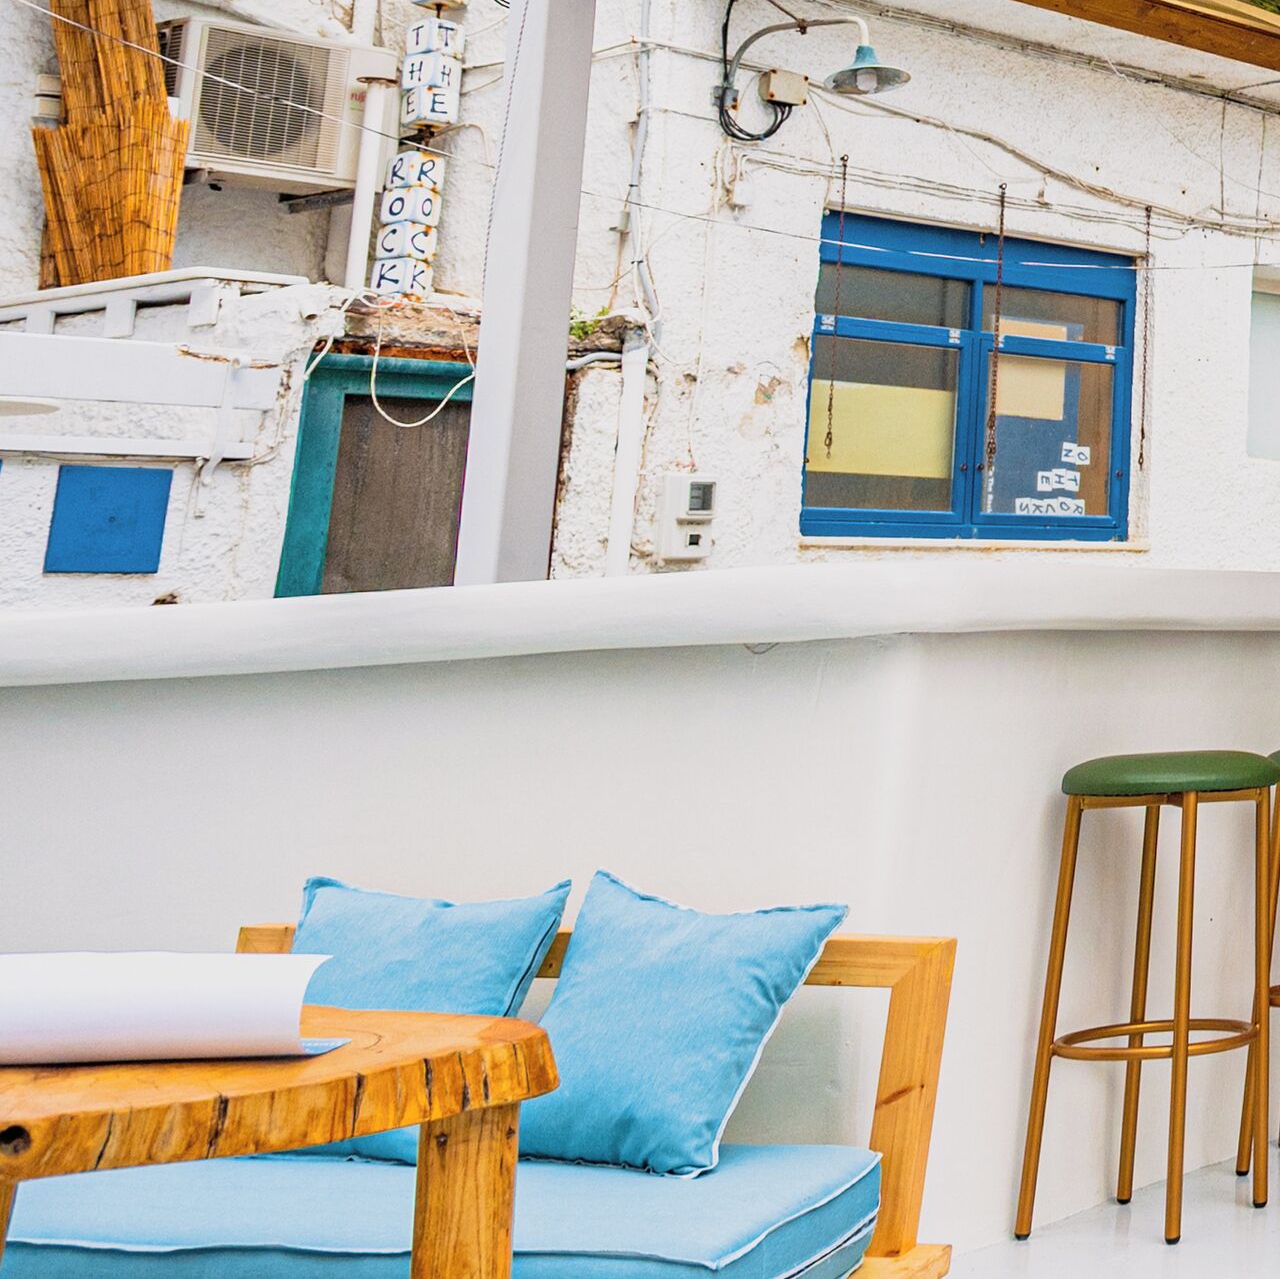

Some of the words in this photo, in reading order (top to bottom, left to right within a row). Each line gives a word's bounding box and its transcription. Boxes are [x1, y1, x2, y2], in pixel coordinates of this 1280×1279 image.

[406, 25, 425, 115] THE
[430, 24, 455, 115] THE
[376, 157, 405, 289] ROCK
[410, 159, 437, 290] ROCK
